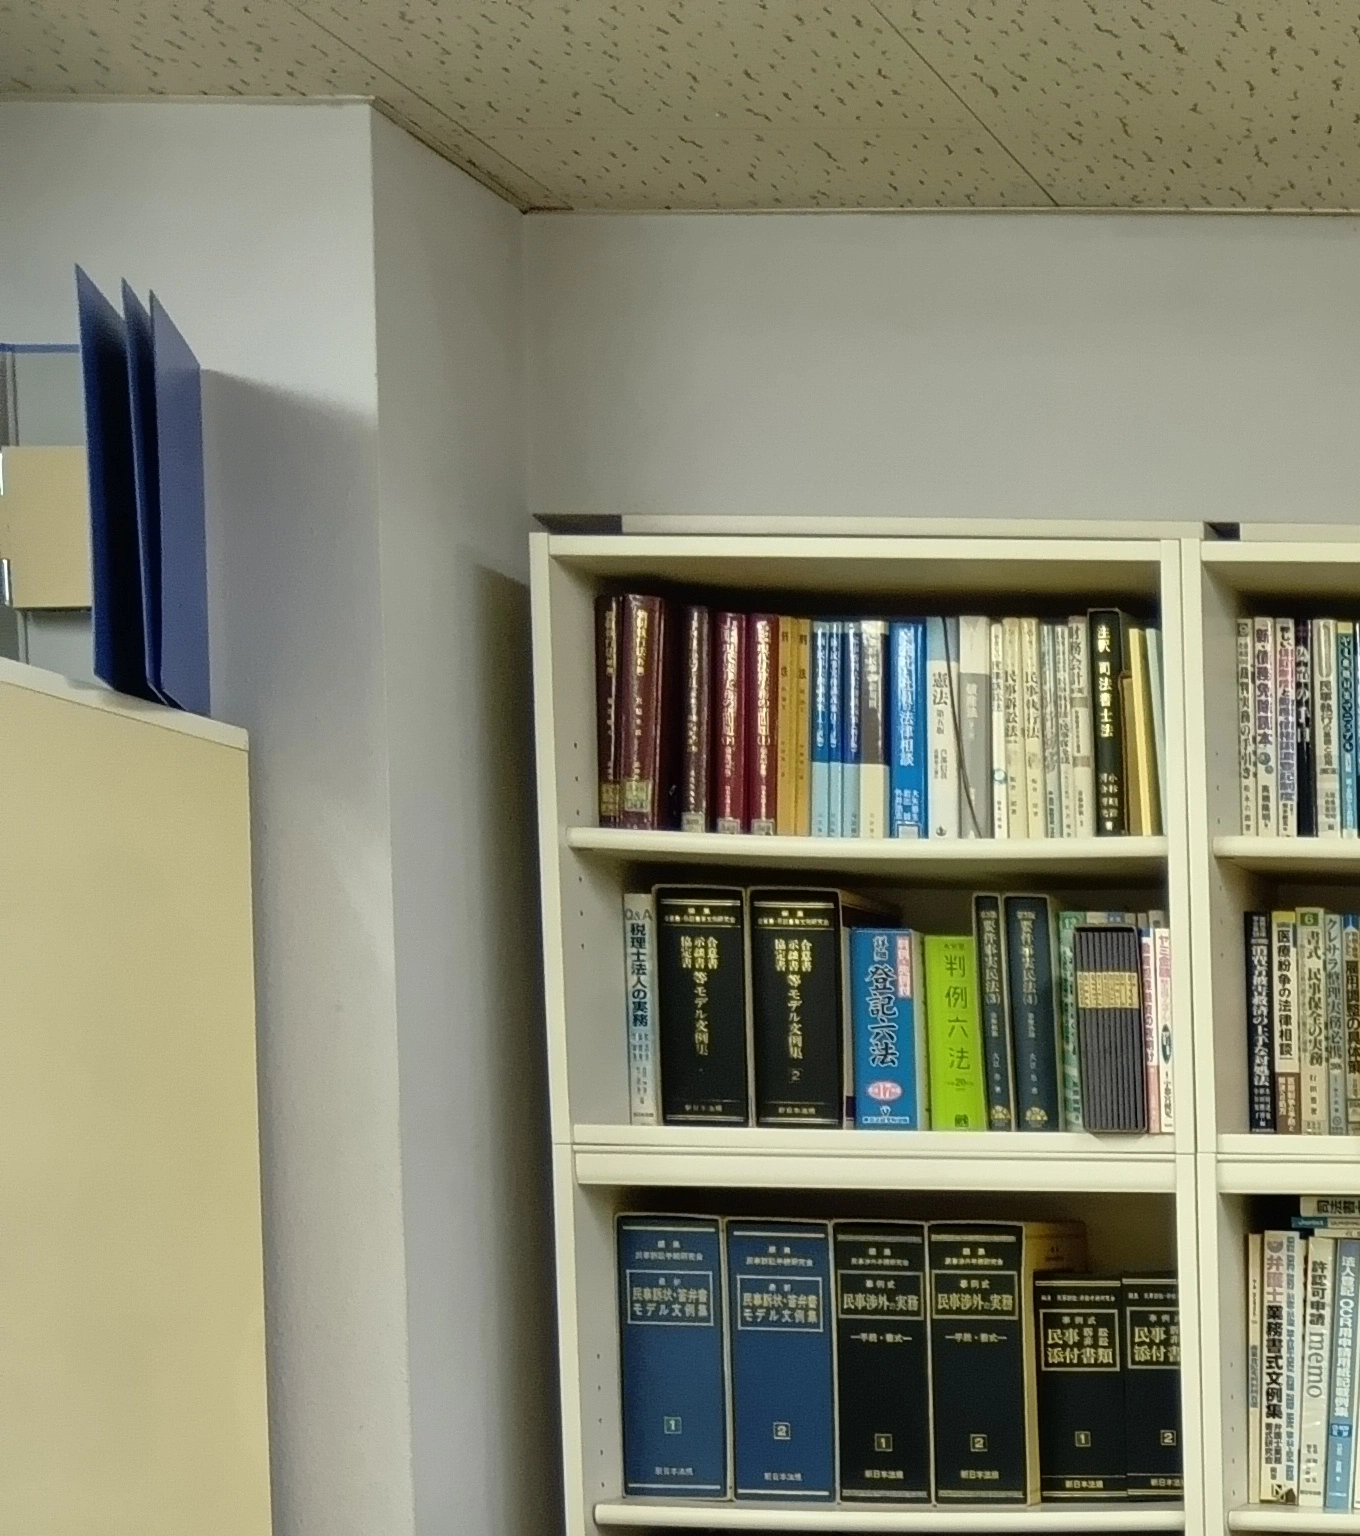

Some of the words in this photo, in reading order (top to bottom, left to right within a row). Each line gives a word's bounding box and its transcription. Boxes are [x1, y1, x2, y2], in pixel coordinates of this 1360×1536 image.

[1099, 661, 1114, 738] 司法書士法
[1304, 913, 1314, 925] 6
[680, 936, 692, 969] 協定書
[708, 936, 719, 969] 合意書
[775, 938, 787, 972] 協定書
[801, 937, 812, 972] 合意書
[1306, 930, 1321, 960] 書式
[631, 923, 648, 1027] 税理士法人の実務
[1277, 929, 1292, 1058] 医療紛争の法律相談
[693, 971, 708, 1056] 等モデル文例集
[787, 974, 803, 1060] 等モデル文例集
[865, 965, 898, 1067] 登記六法
[944, 955, 971, 1071] 判例六法
[1307, 967, 1324, 1067] 民事保全の実務
[633, 1287, 708, 1303] 民事訴状・答弁書
[743, 1293, 818, 1310] 民事訴状・答弁書
[842, 1293, 919, 1313] 民事渉外の実務
[936, 1293, 1014, 1312] 民事渉外の実務
[1309, 1260, 1327, 1326] 許認可申請
[633, 1304, 708, 1318] モデル文例集
[743, 1309, 818, 1323] モデル文例集
[1265, 1253, 1285, 1420] 弁護士業務書式文例集
[1047, 1347, 1114, 1364] 添付書類
[1307, 1330, 1326, 1398] memo
